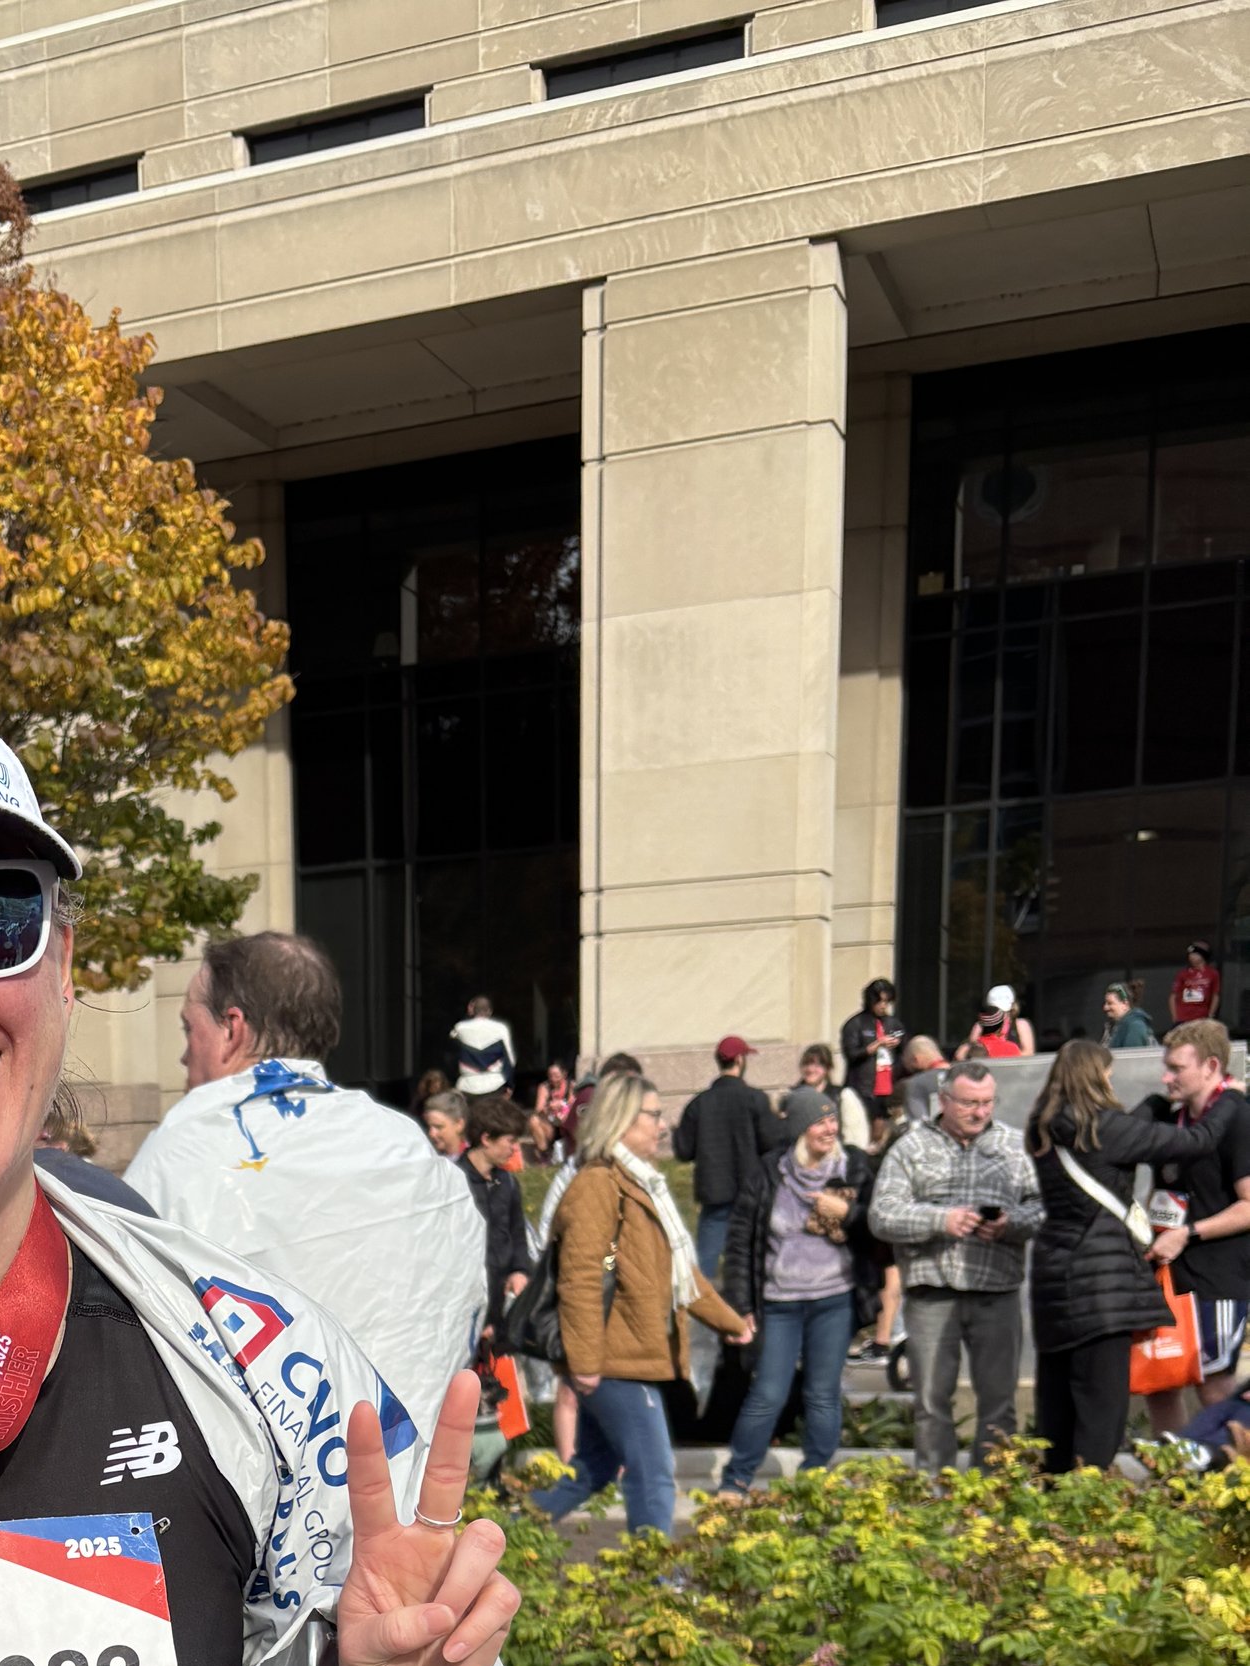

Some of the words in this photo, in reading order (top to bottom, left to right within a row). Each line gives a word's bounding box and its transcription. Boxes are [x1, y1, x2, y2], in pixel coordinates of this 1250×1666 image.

[280, 1351, 348, 1488] CNO
[64, 1536, 122, 1560] 2025
[303, 1509, 333, 1581] GROU
